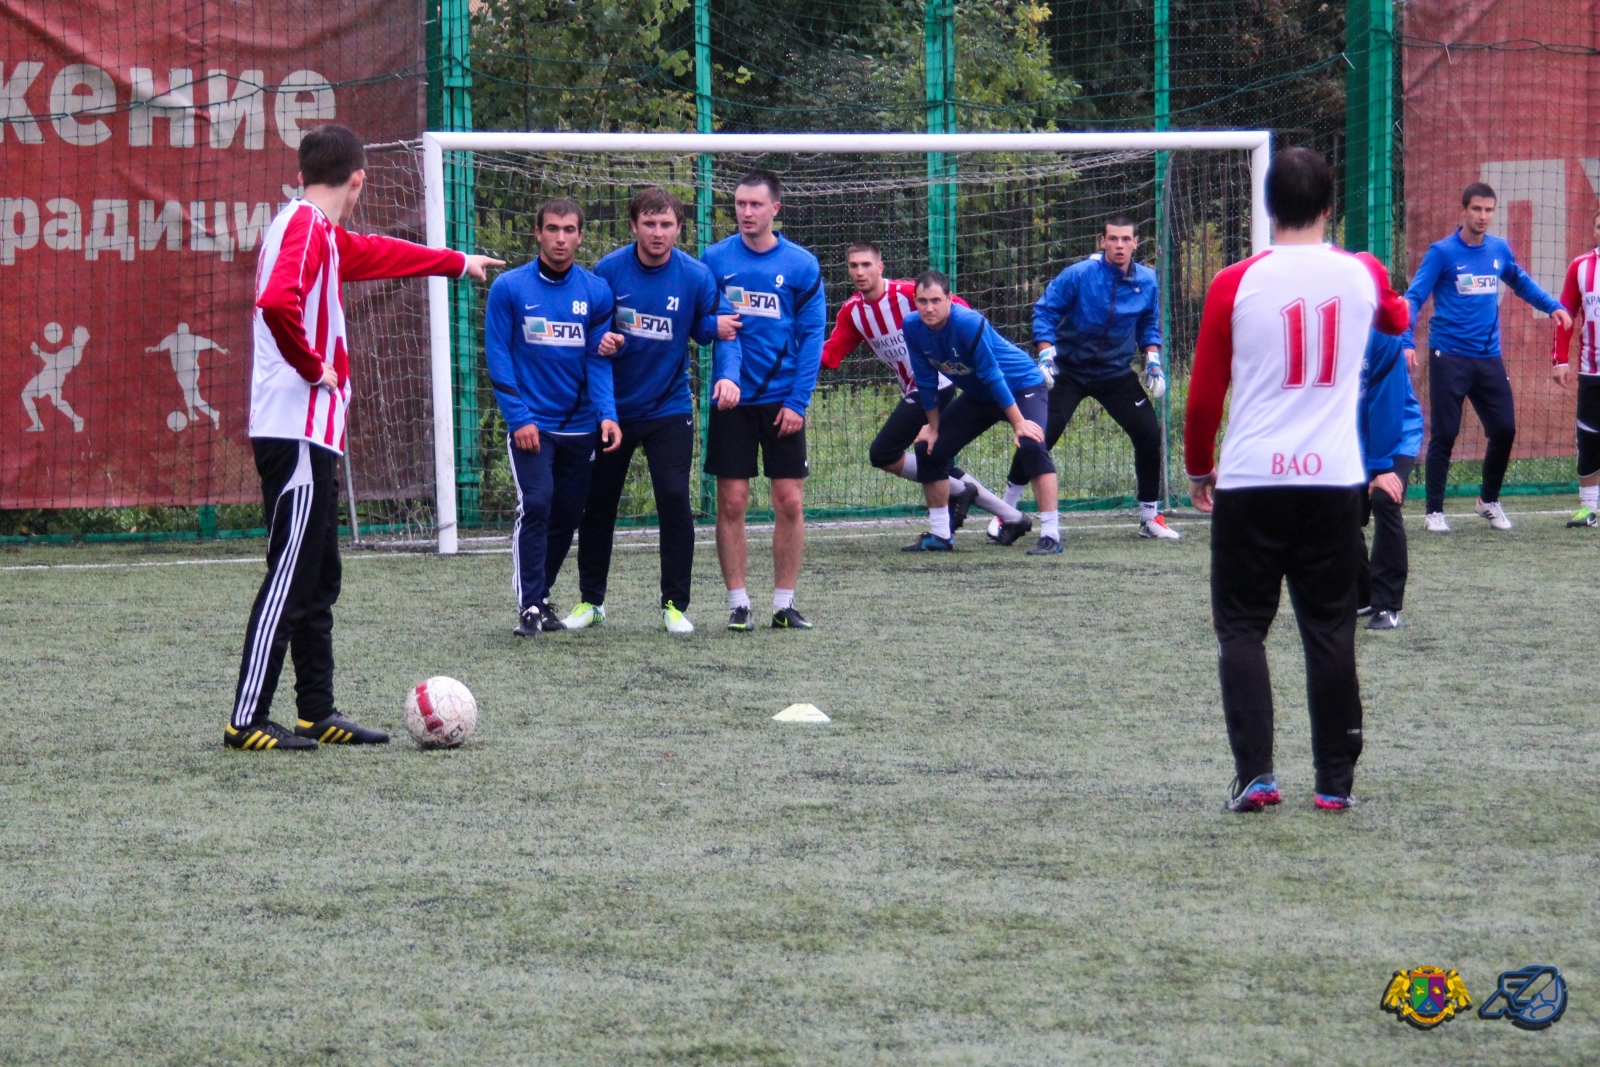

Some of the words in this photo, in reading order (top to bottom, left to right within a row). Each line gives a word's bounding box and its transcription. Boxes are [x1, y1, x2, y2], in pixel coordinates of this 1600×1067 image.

[0, 184, 304, 266] радици
[775, 274, 784, 288] 9
[1478, 277, 1496, 288] БПА
[572, 300, 588, 315] 88
[666, 295, 680, 311] 21
[749, 294, 777, 310] БПА
[552, 324, 582, 339] БПА
[641, 316, 670, 333] БПА
[1280, 296, 1341, 389] 11
